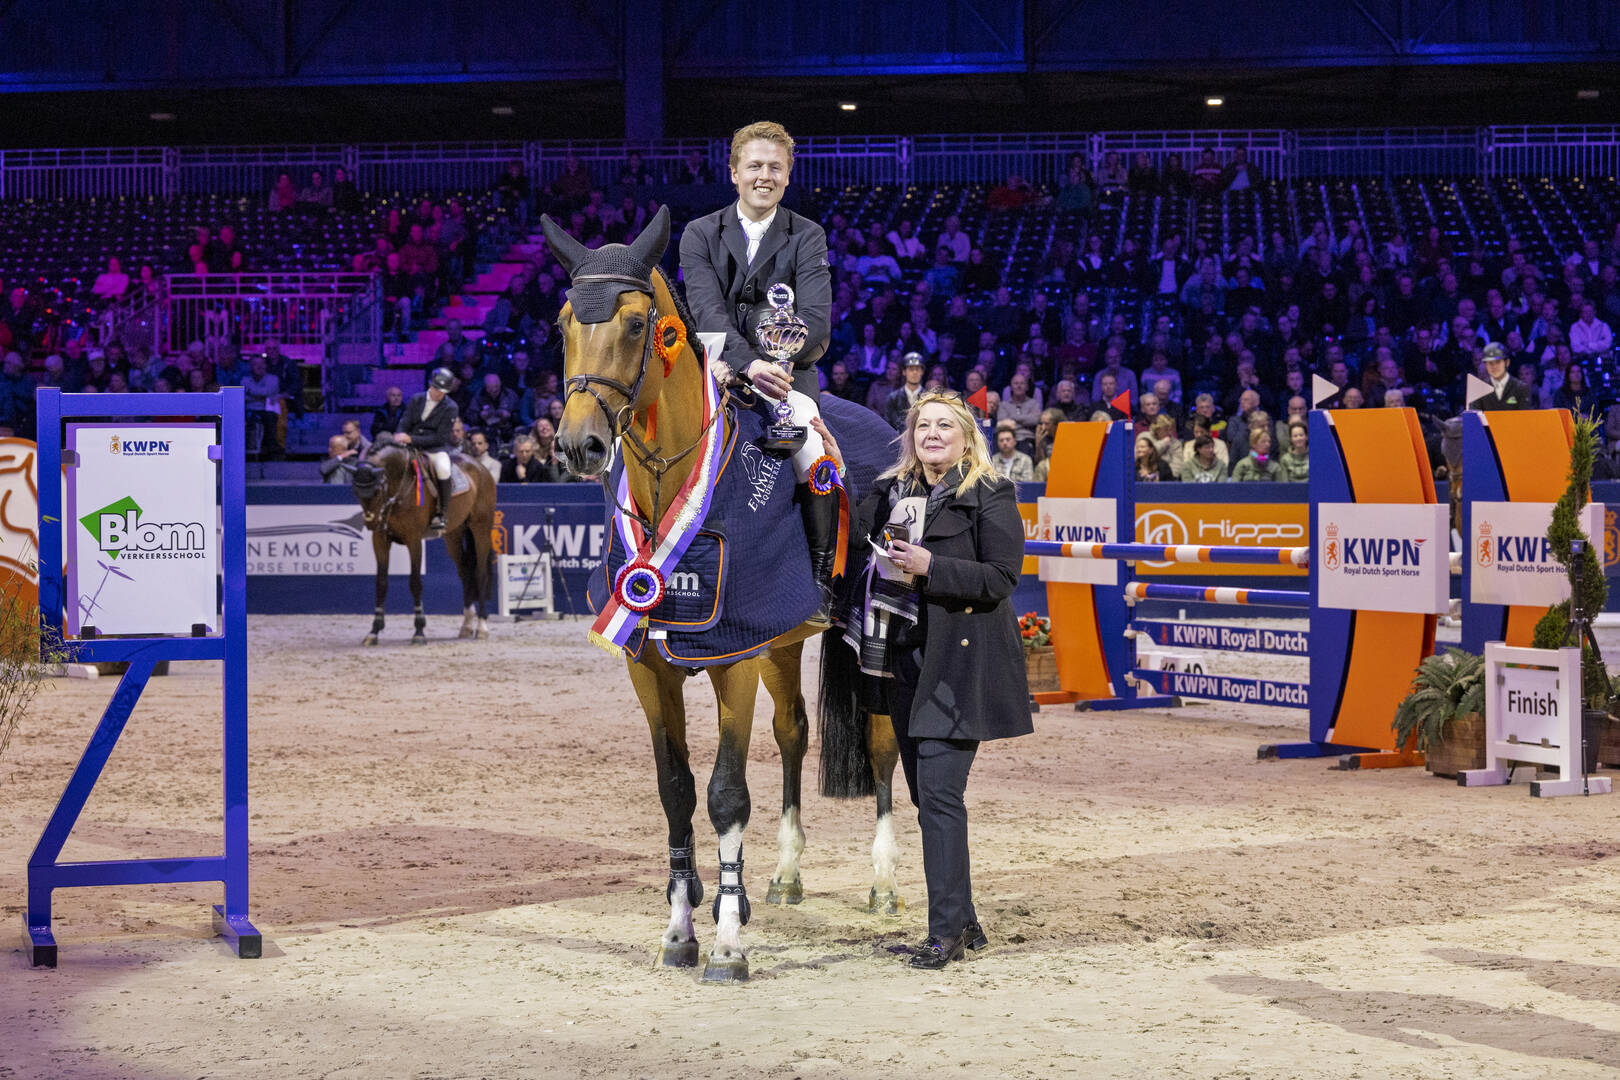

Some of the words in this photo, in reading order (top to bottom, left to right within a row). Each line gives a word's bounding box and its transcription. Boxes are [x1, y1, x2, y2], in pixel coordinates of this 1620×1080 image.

[122, 440, 170, 452] KWPN
[748, 458, 776, 512] EMME
[760, 460, 783, 506] EQUESTRIA
[100, 509, 204, 552] Blom
[513, 524, 605, 557] KWP
[1055, 526, 1107, 542] KWPN
[1198, 520, 1304, 544] Hippo
[248, 542, 358, 557] NEMONE
[1344, 538, 1420, 566] KWPN
[1498, 536, 1552, 562] KWP
[246, 562, 283, 573] ORSE
[293, 562, 355, 573] TRUCKS
[1344, 566, 1360, 576] Royal
[1362, 567, 1380, 575] Dutch
[1382, 568, 1400, 577] Sport
[1498, 564, 1514, 572] Royal
[1536, 565, 1554, 574] Sport
[1173, 625, 1218, 645] KWPN
[1220, 628, 1260, 650] Royal
[1264, 632, 1308, 652] Dutch
[1174, 675, 1218, 696] KWPN
[1222, 679, 1260, 702] Royal
[1264, 682, 1308, 704] Dutch
[1508, 690, 1558, 716] Finish
